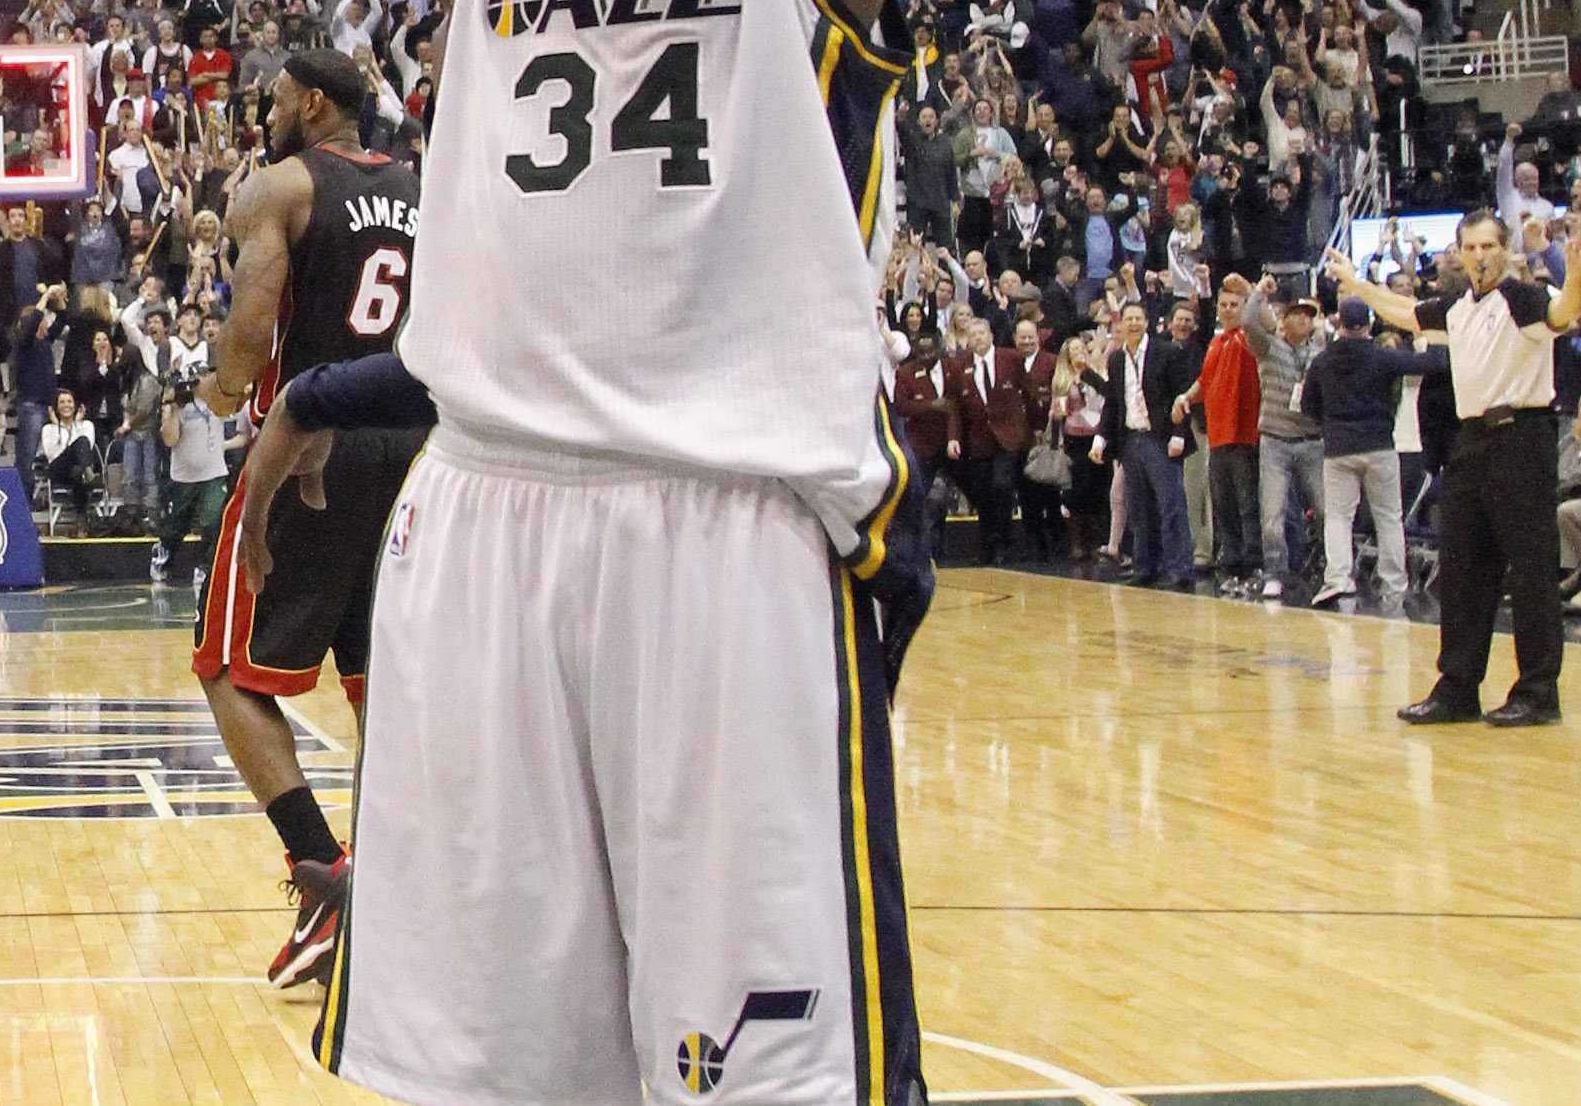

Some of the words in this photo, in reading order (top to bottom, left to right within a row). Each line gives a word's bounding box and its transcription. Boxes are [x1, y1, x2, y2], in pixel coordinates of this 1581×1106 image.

[505, 41, 713, 194] 34
[345, 195, 420, 238] JAMES
[347, 246, 408, 336] 6
